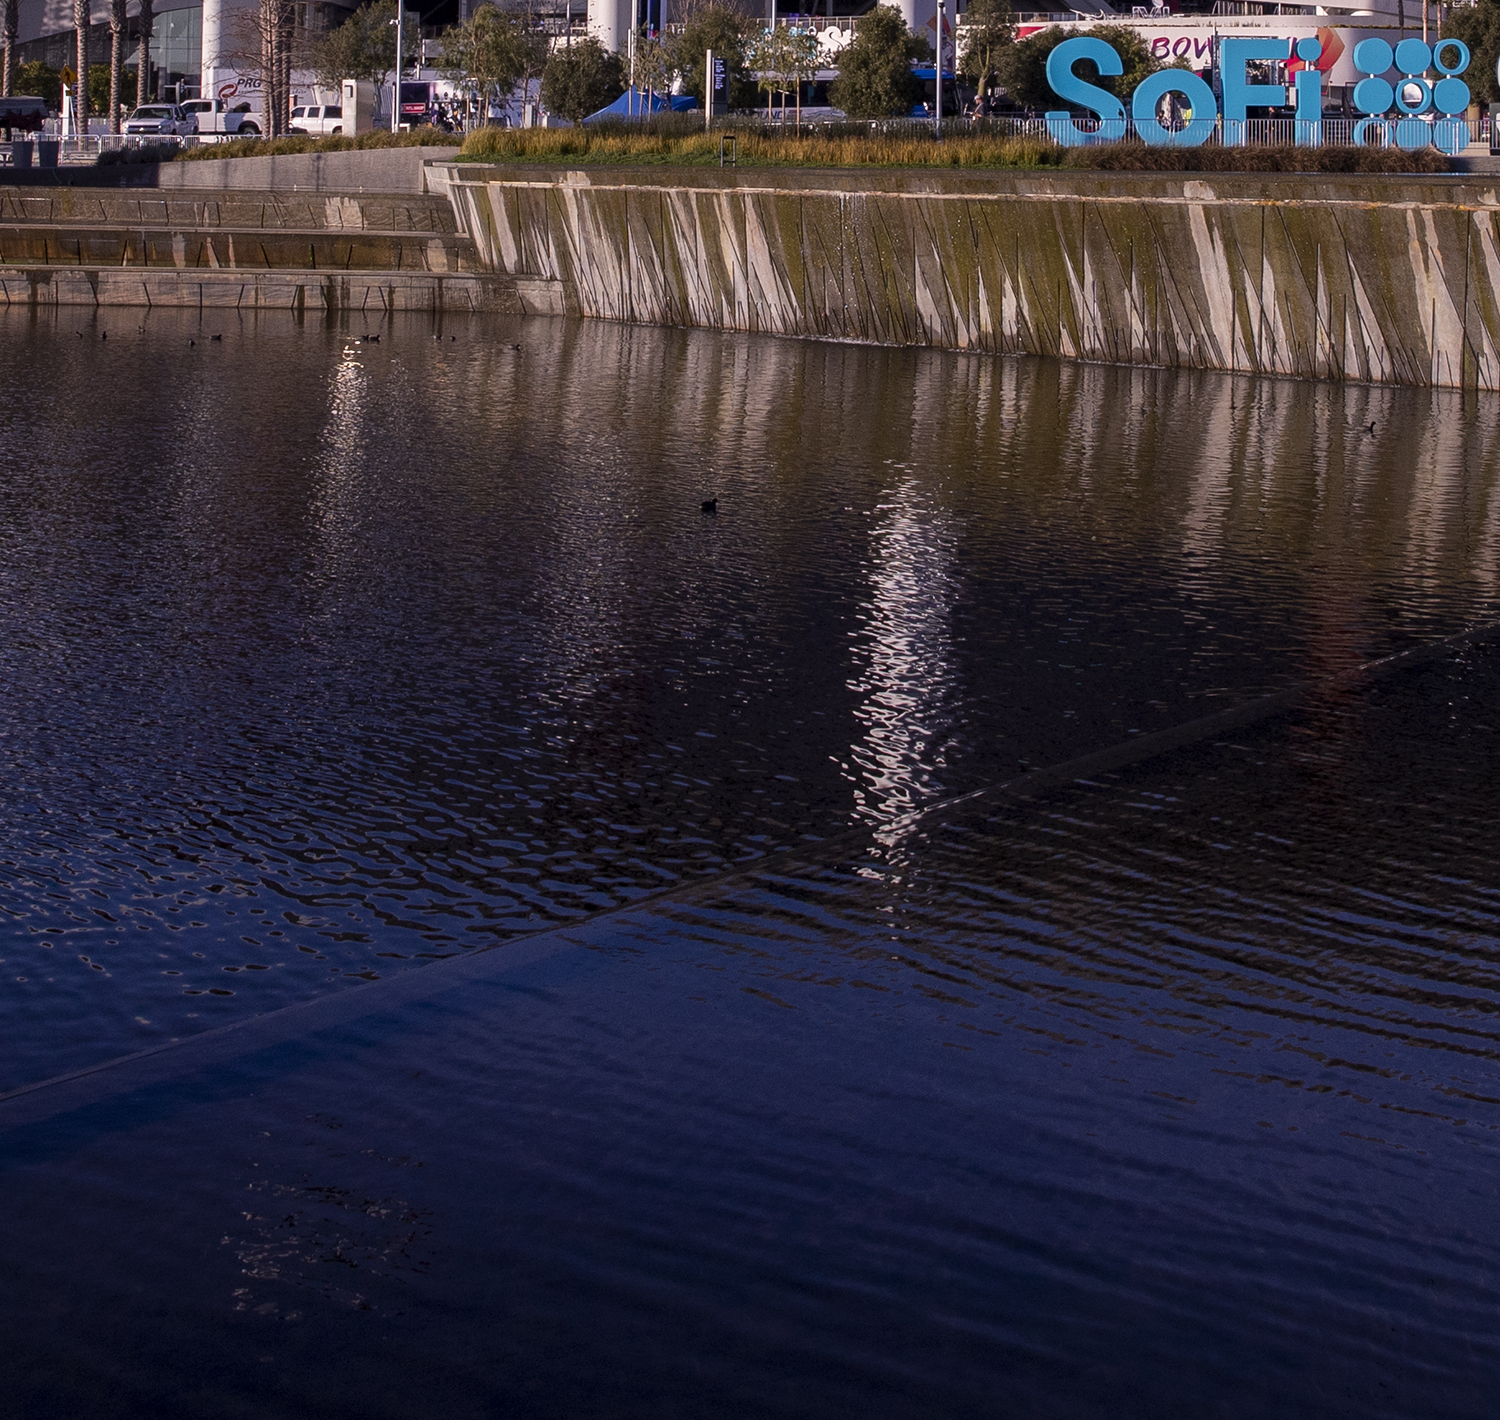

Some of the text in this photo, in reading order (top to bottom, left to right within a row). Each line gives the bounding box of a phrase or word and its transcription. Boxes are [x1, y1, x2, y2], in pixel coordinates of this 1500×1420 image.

[1151, 36, 1213, 60] BOW
[237, 78, 261, 88] PRG
[1044, 37, 1322, 148] SoFi
